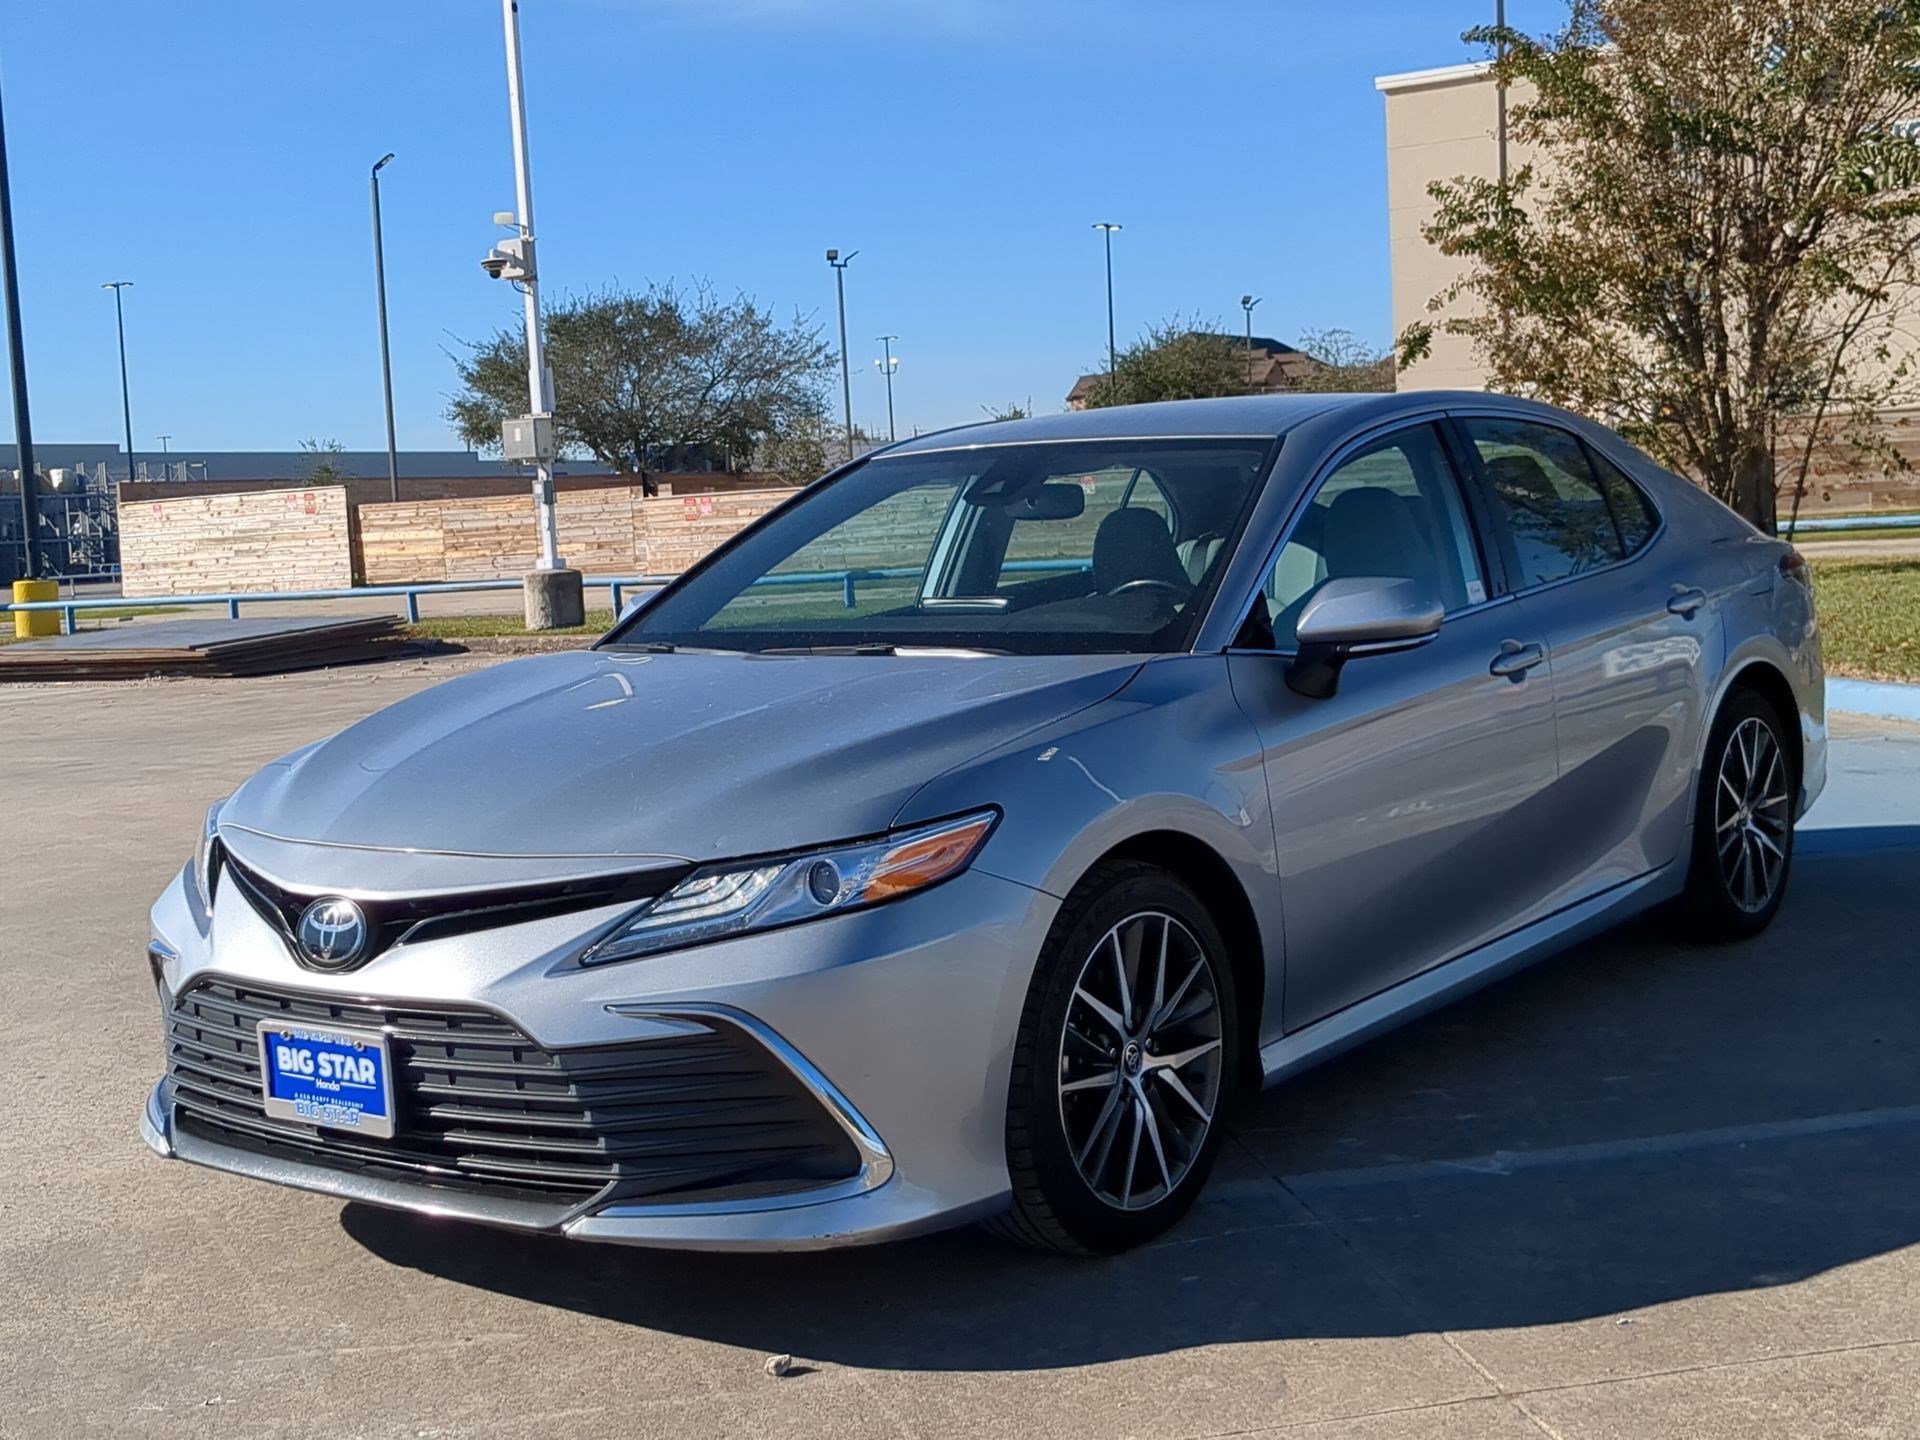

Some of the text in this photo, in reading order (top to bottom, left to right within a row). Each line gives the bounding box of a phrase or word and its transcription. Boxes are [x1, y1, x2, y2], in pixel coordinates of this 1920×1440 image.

[276, 1045, 377, 1085] BIG STAR
[315, 1078, 341, 1092] Honda
[294, 1099, 360, 1126] BIG STAR
